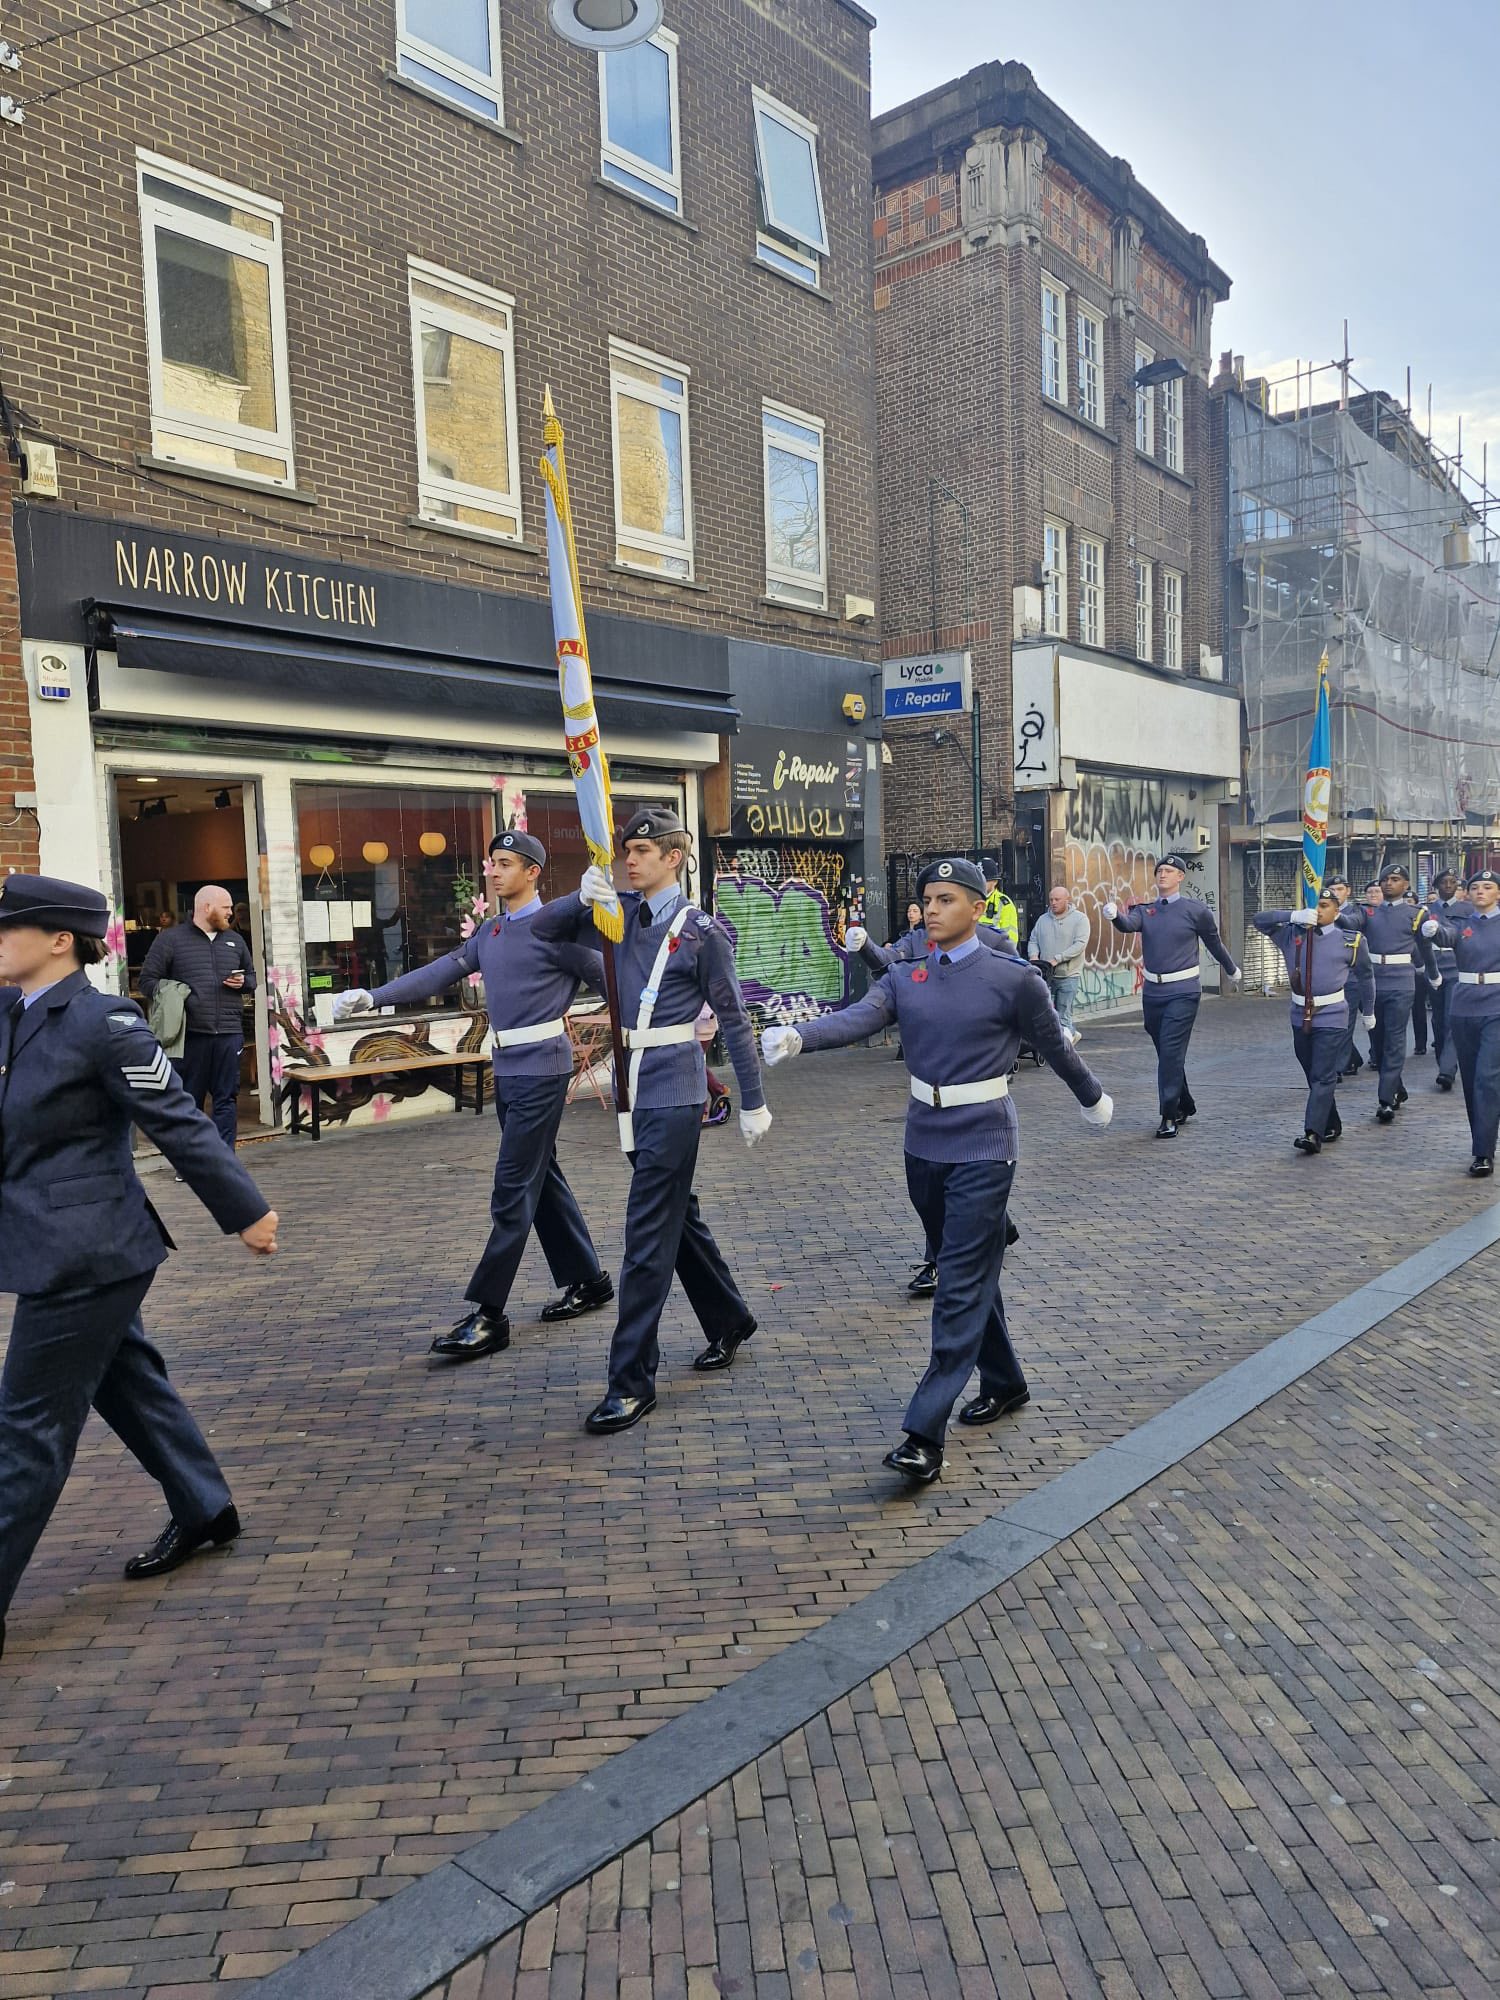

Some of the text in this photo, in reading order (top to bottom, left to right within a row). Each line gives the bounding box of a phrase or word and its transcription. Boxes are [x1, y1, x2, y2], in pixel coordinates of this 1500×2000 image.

[116, 540, 376, 628] NARROW KITCHEN
[901, 664, 933, 680] Lyca
